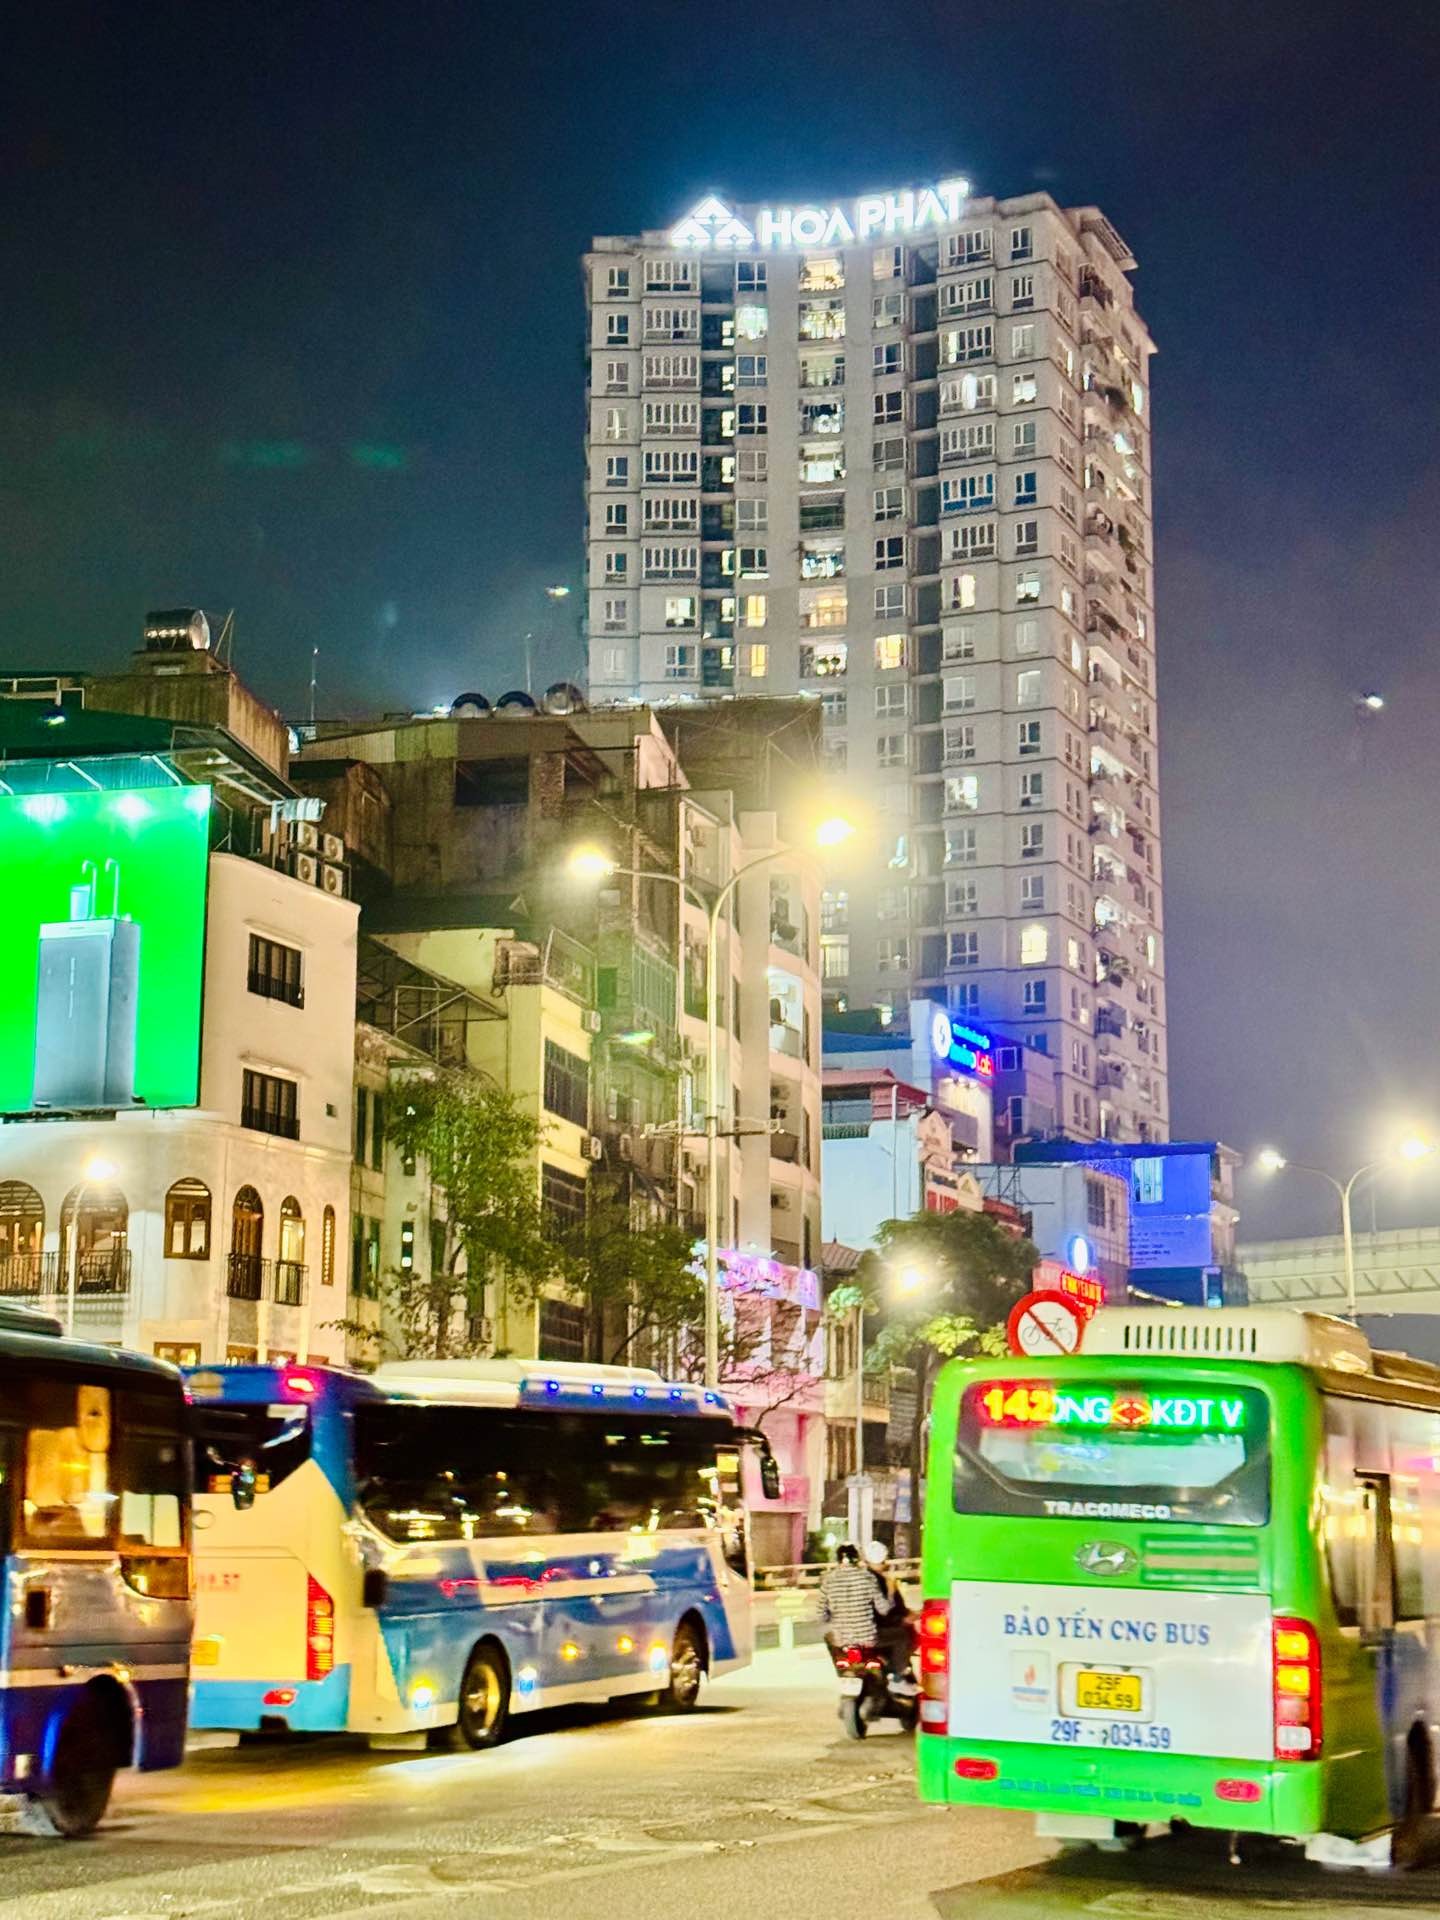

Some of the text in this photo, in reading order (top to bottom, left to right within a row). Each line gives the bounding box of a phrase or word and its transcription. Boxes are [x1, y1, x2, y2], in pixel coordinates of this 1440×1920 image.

[983, 1388, 1054, 1422] 142
[1152, 1399, 1214, 1426] KĐT
[1043, 1500, 1171, 1520] TRACOMECO
[1003, 1605, 1211, 1646] BẢO YẾN CNG BUS
[1051, 1719, 1082, 1742] 29F
